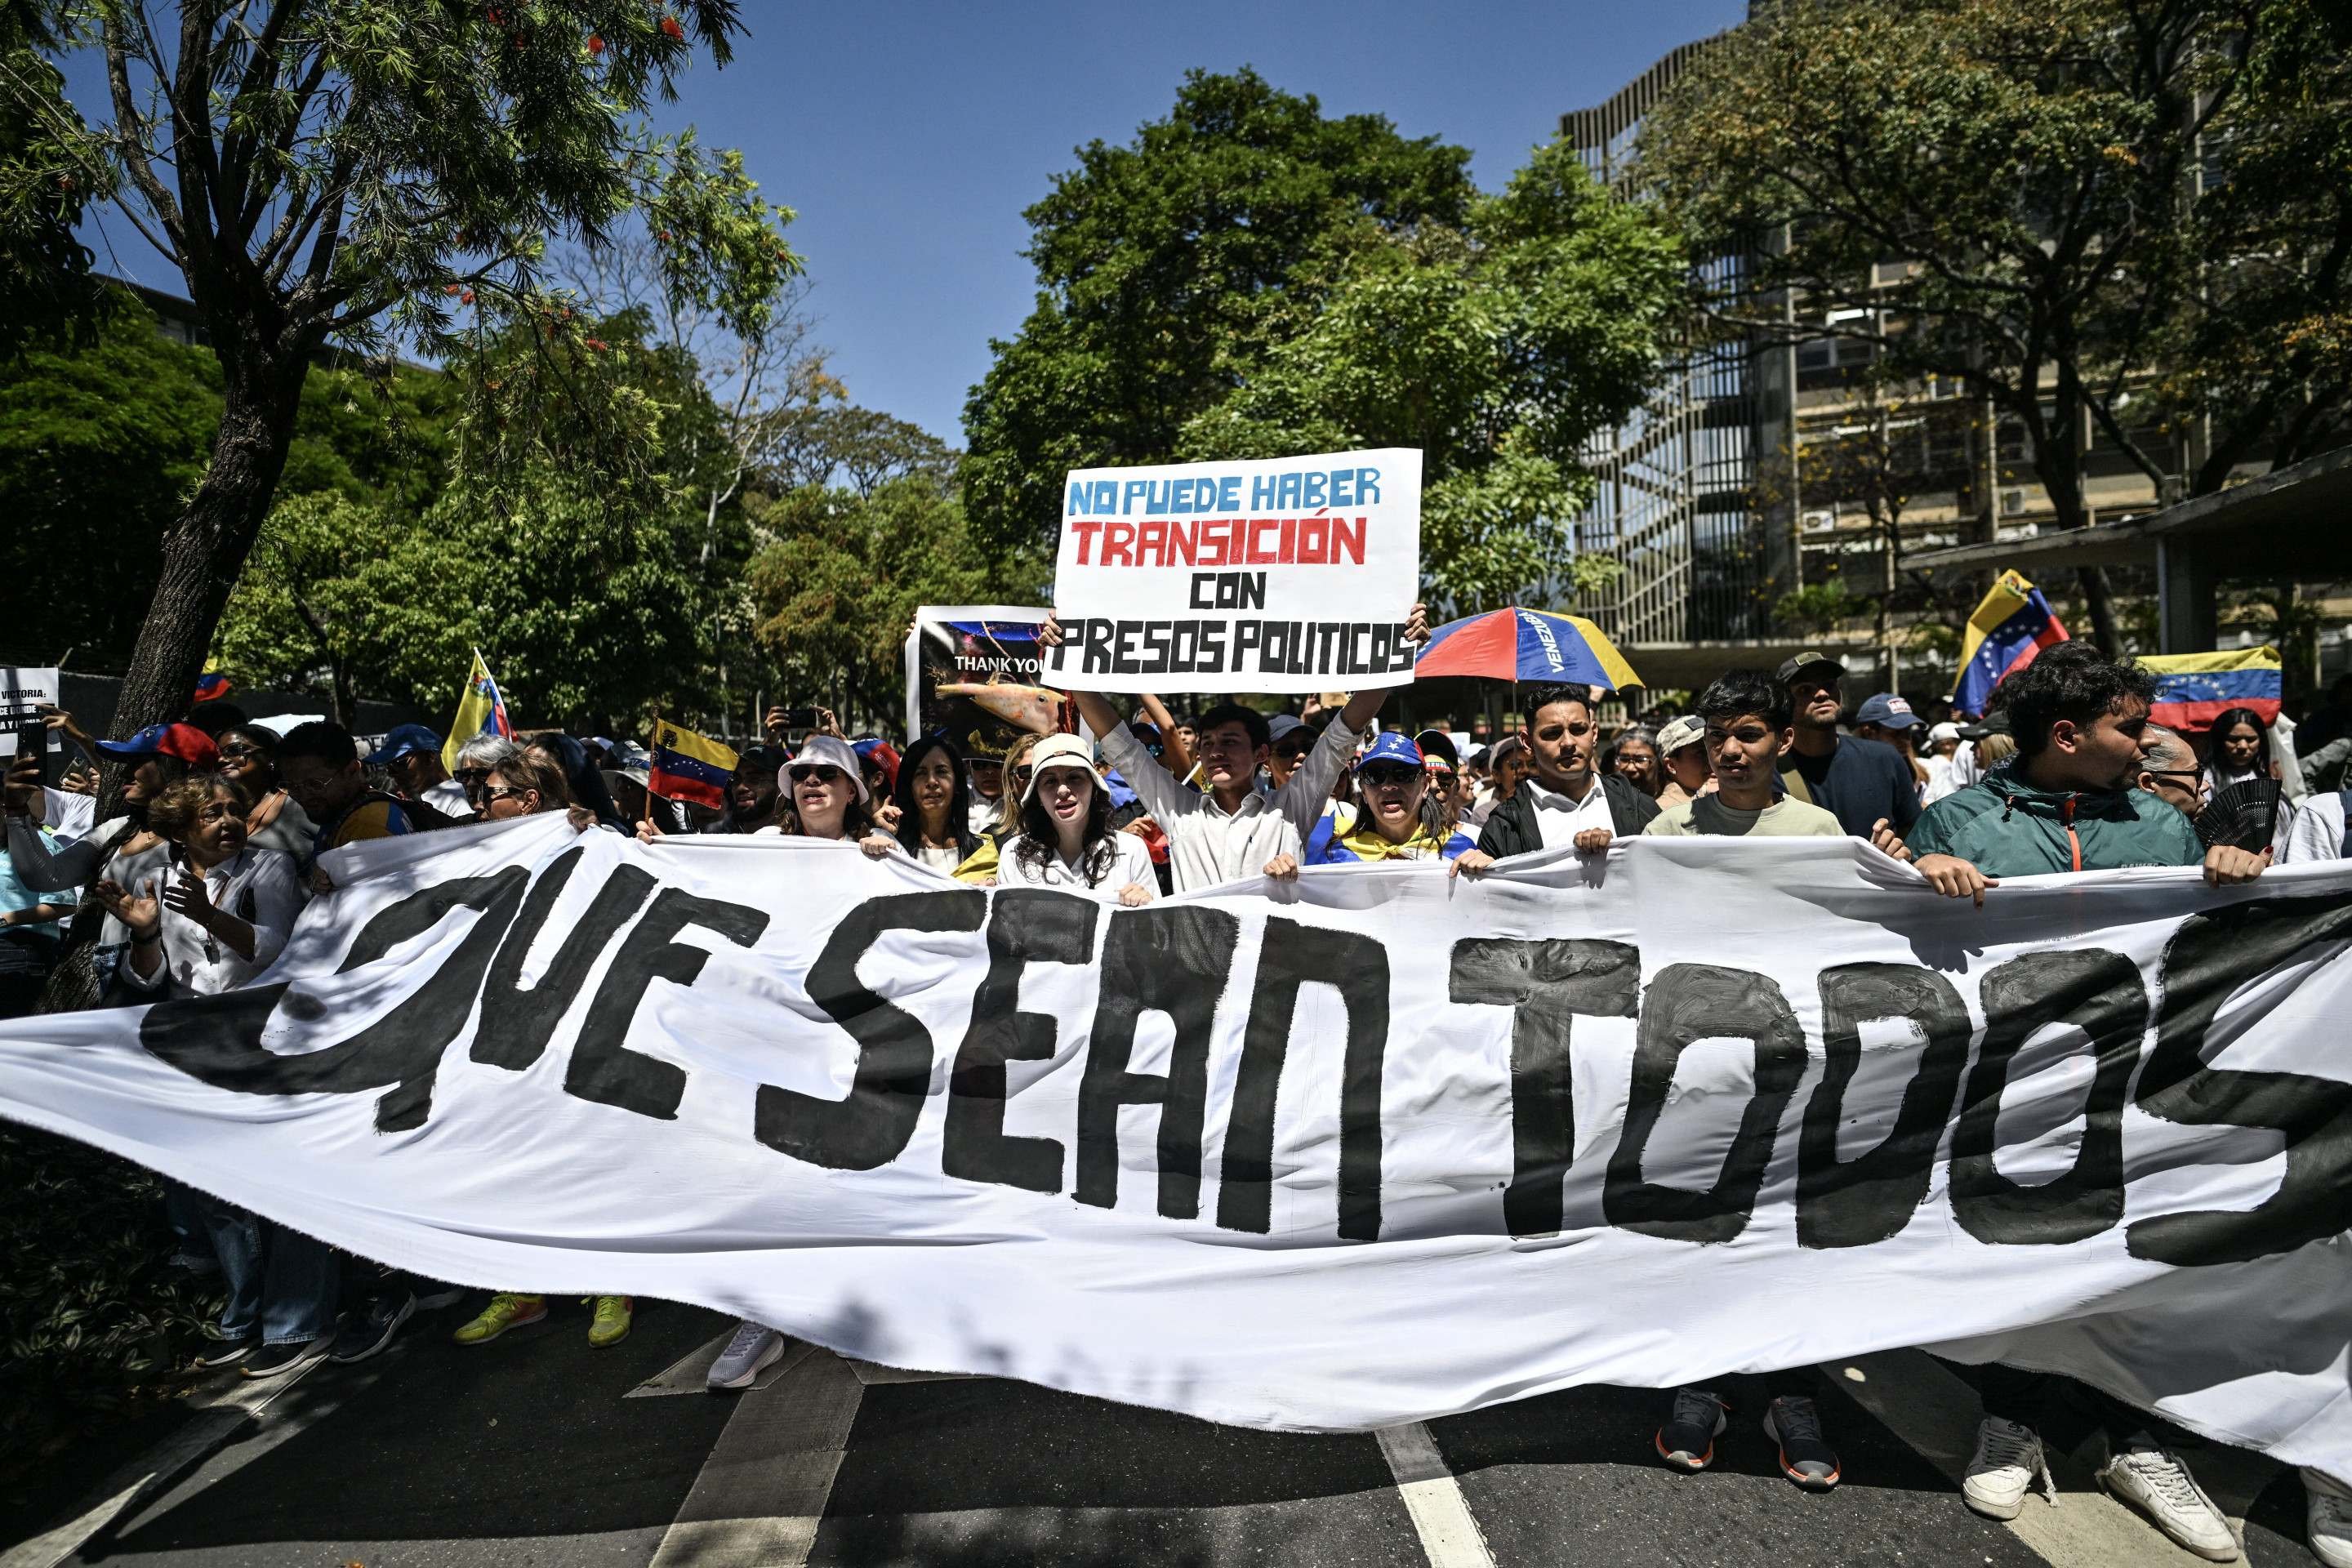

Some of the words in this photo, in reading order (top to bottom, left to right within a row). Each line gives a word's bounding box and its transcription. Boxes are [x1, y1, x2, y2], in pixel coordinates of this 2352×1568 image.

[1068, 481, 1118, 516] NO
[1123, 477, 1242, 515] PUEDE
[1250, 467, 1380, 510] HABER
[1071, 508, 1367, 567] TRANSICIÓN
[1189, 572, 1267, 610] CON
[954, 656, 1012, 672] THANK
[1051, 618, 1227, 674] PRESOS
[1232, 620, 1415, 675] POLITICOS
[2, 689, 47, 699] VICTORIA:
[10, 705, 37, 715] DONDE
[140, 846, 770, 1134] QUE
[755, 889, 1390, 1241] SEAN
[1449, 889, 2352, 1267] TODOS
